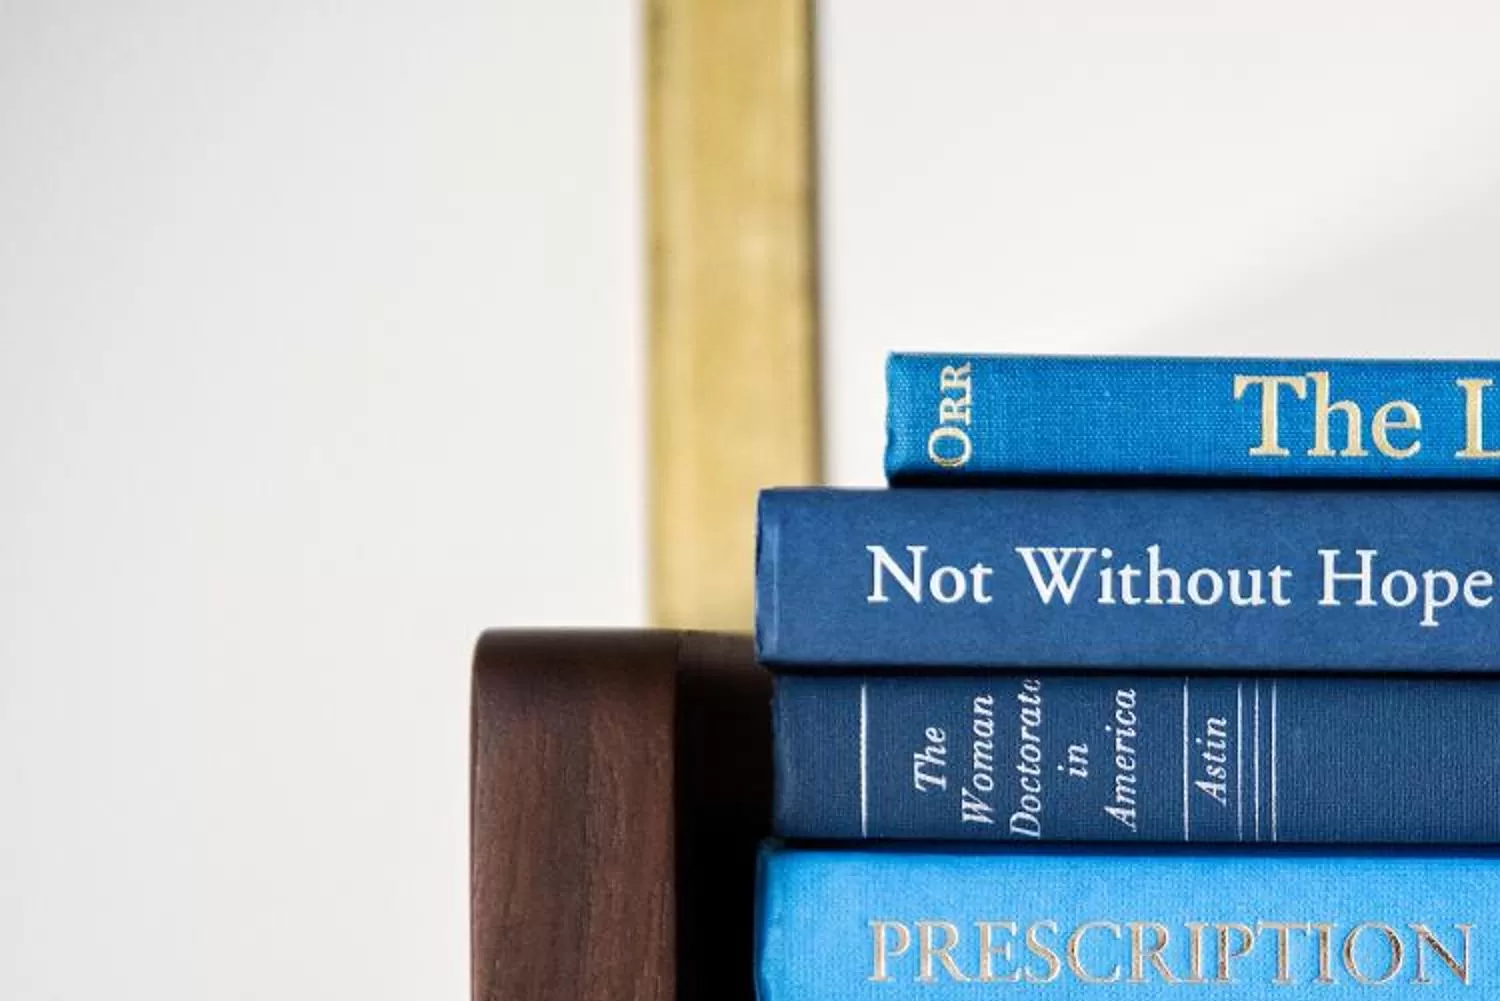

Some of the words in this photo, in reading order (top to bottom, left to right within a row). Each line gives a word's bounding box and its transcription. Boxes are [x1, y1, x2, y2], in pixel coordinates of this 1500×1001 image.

[927, 361, 972, 467] ORR
[1233, 372, 1423, 458] The
[867, 545, 992, 604] Not
[1016, 545, 1292, 606] Without
[1317, 549, 1494, 626] Hope
[914, 726, 946, 792] The
[962, 694, 994, 824] Woman
[1057, 743, 1088, 778] in
[1104, 688, 1137, 833] America
[1195, 716, 1227, 806] Astin
[868, 919, 1475, 985] PRESCRIPTION
